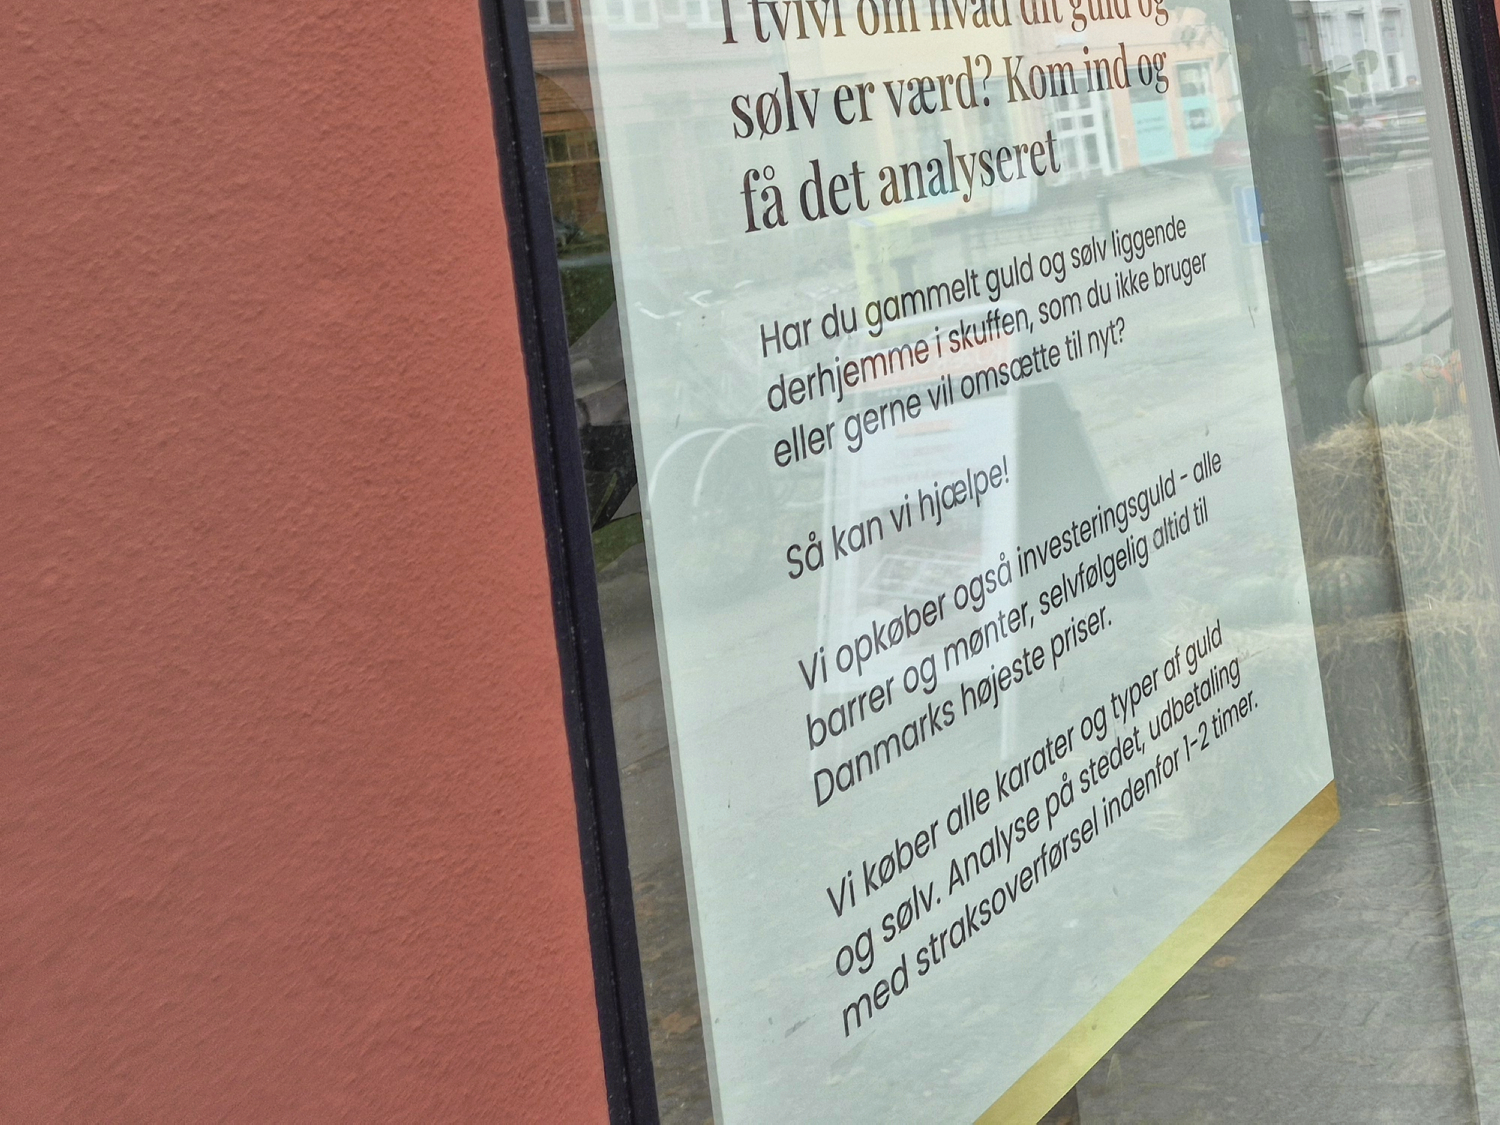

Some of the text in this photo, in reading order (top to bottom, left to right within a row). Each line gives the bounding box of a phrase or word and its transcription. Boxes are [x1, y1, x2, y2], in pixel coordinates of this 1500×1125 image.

[731, 43, 1170, 141] sølv er værd? Kom ind og
[740, 130, 1061, 233] få det analyseret
[760, 215, 1187, 358] Har du gammelt guld og sølv liggende
[767, 250, 1207, 413] derhjemme i skuffen, som du ikke bruger
[773, 317, 1125, 469] eller gerne vil omsætte til nyt?
[786, 455, 1011, 580] Så kan vi hjælpe!
[797, 651, 827, 692] Vi
[836, 598, 946, 680] opkøber
[953, 552, 1013, 611] også
[1018, 468, 1176, 579] investeringsguld
[1193, 449, 1223, 485] alle
[806, 496, 1209, 752] barrer og mønter, selvfølgelig altid til
[813, 604, 1112, 807] Danmarks højeste priser.
[826, 619, 1224, 920] Vi køber alle karater og typer af guld
[834, 657, 1242, 981] og sølv. Analyse på stedet, udbetaling
[841, 689, 1259, 1038] med straksoverførsel indenfor 1-2 timer.
